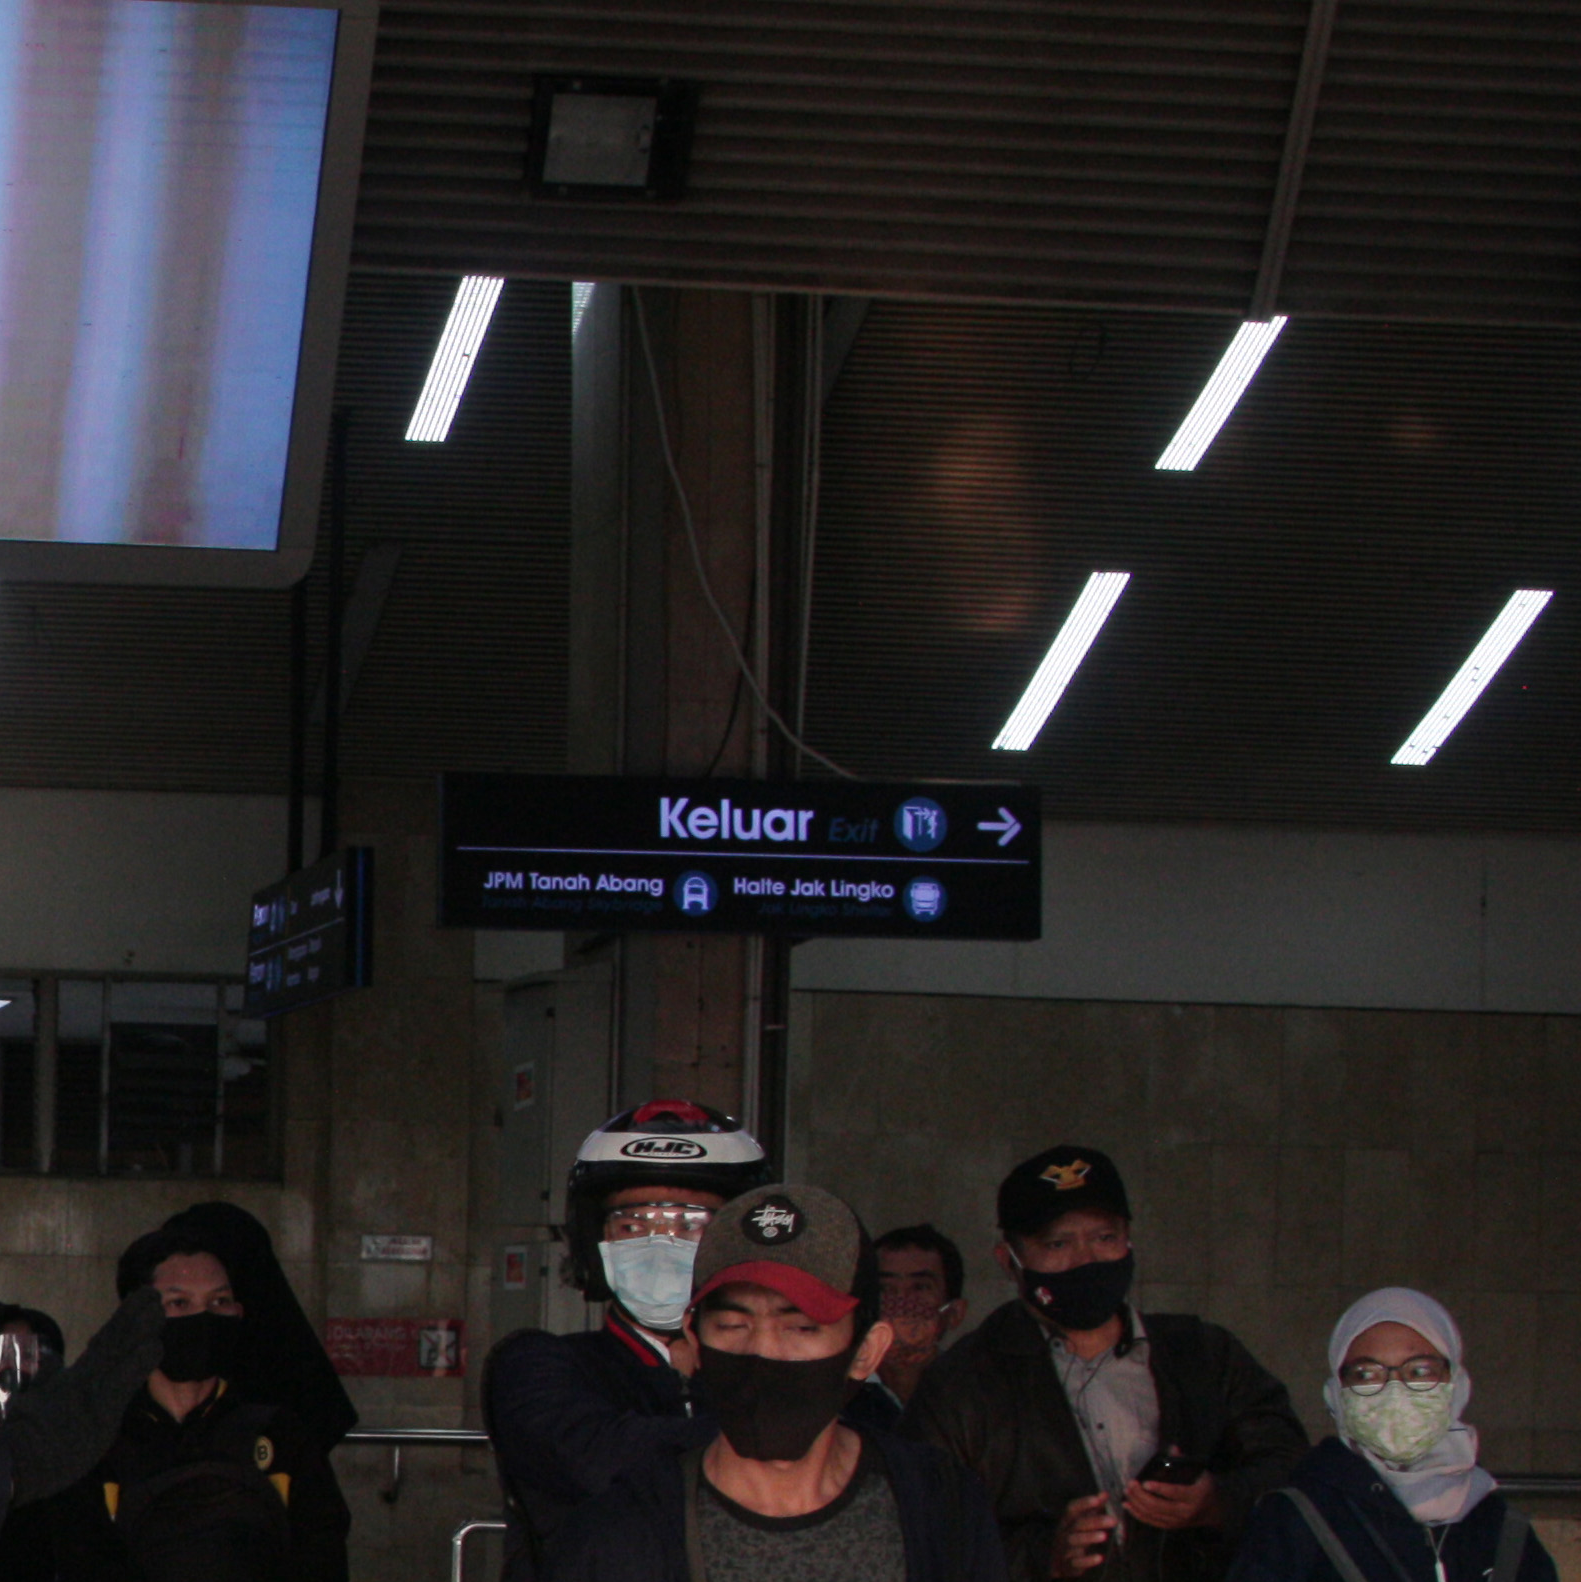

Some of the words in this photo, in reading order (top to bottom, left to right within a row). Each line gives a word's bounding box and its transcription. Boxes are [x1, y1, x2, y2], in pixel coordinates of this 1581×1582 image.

[659, 796, 815, 842] Keluar
[827, 816, 881, 844] Exit
[483, 871, 524, 890] JPM
[528, 871, 591, 891] Tanah
[595, 873, 665, 898] Abang
[733, 876, 785, 896] Halte
[790, 877, 826, 898] Jak
[830, 878, 895, 903] Lingko
[634, 1141, 695, 1155] HJC
